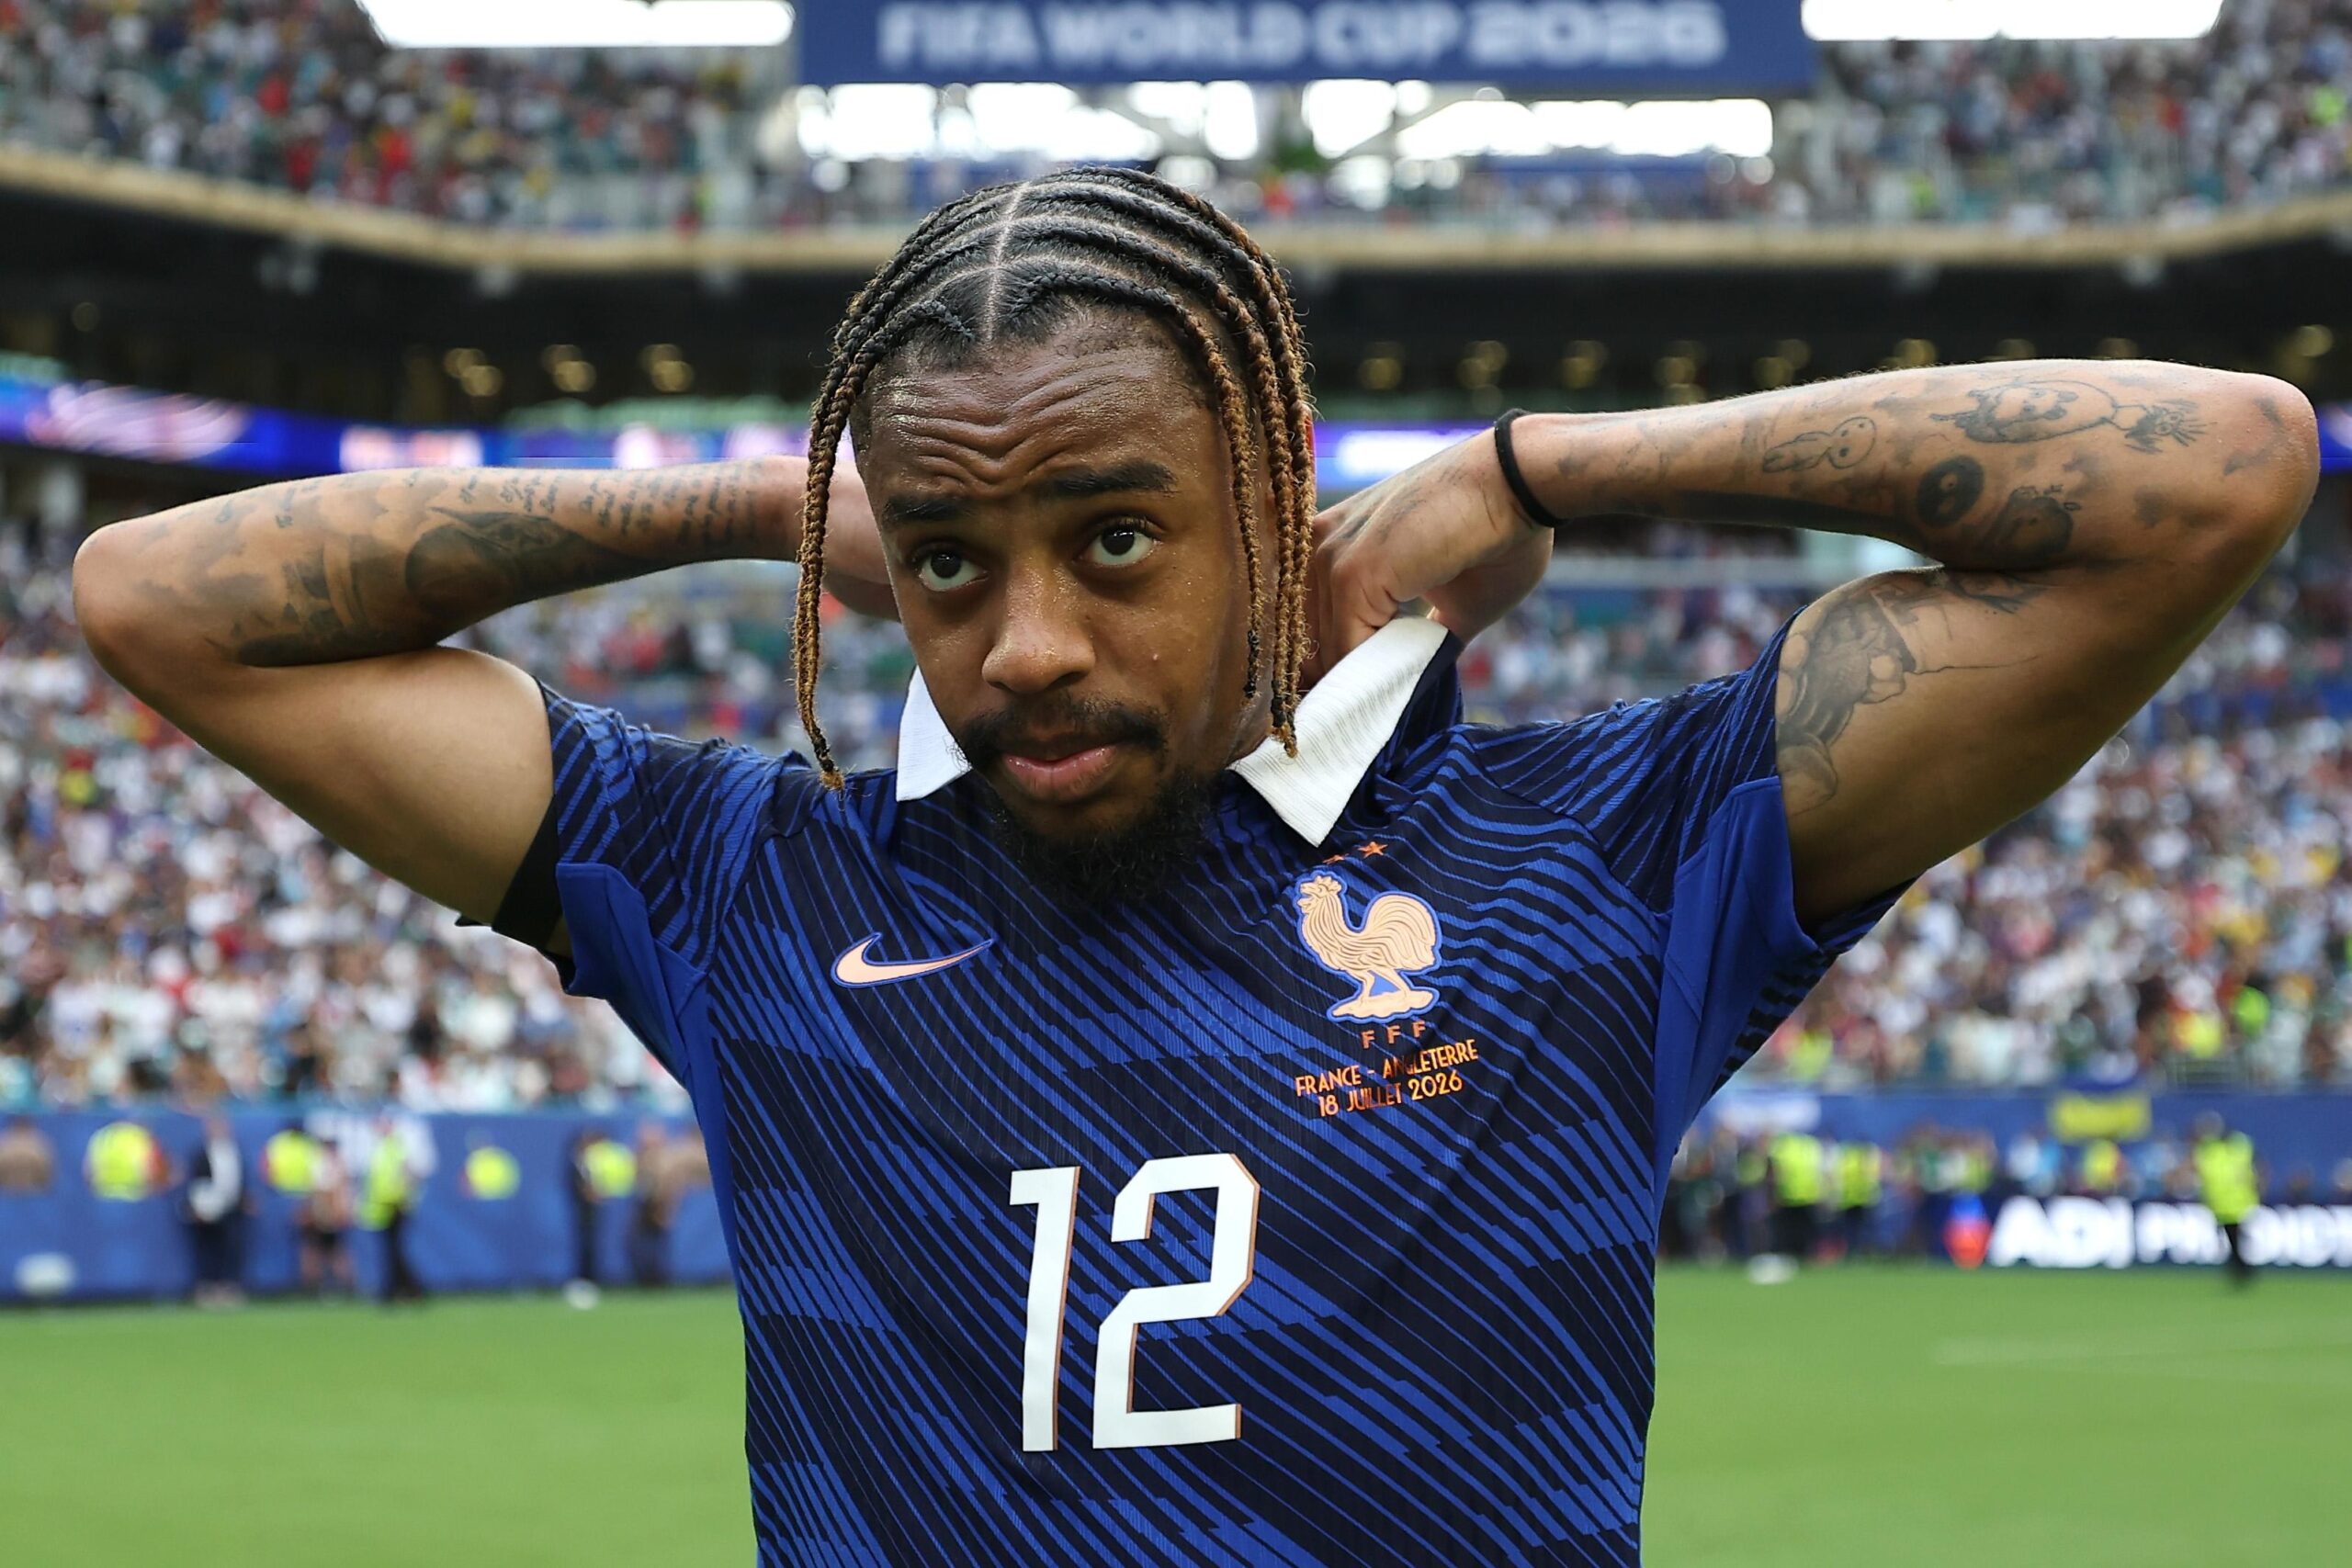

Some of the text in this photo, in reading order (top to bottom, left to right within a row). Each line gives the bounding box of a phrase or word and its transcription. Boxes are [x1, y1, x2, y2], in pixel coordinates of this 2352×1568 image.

[879, 2, 1727, 68] FIFA WORLD CUP 2026
[1295, 1066, 1362, 1097] FRANCE
[1319, 1069, 1463, 1117] 18 JUILLET 2026
[1990, 1196, 2134, 1268] ADI
[1010, 1153, 1261, 1451] 12
